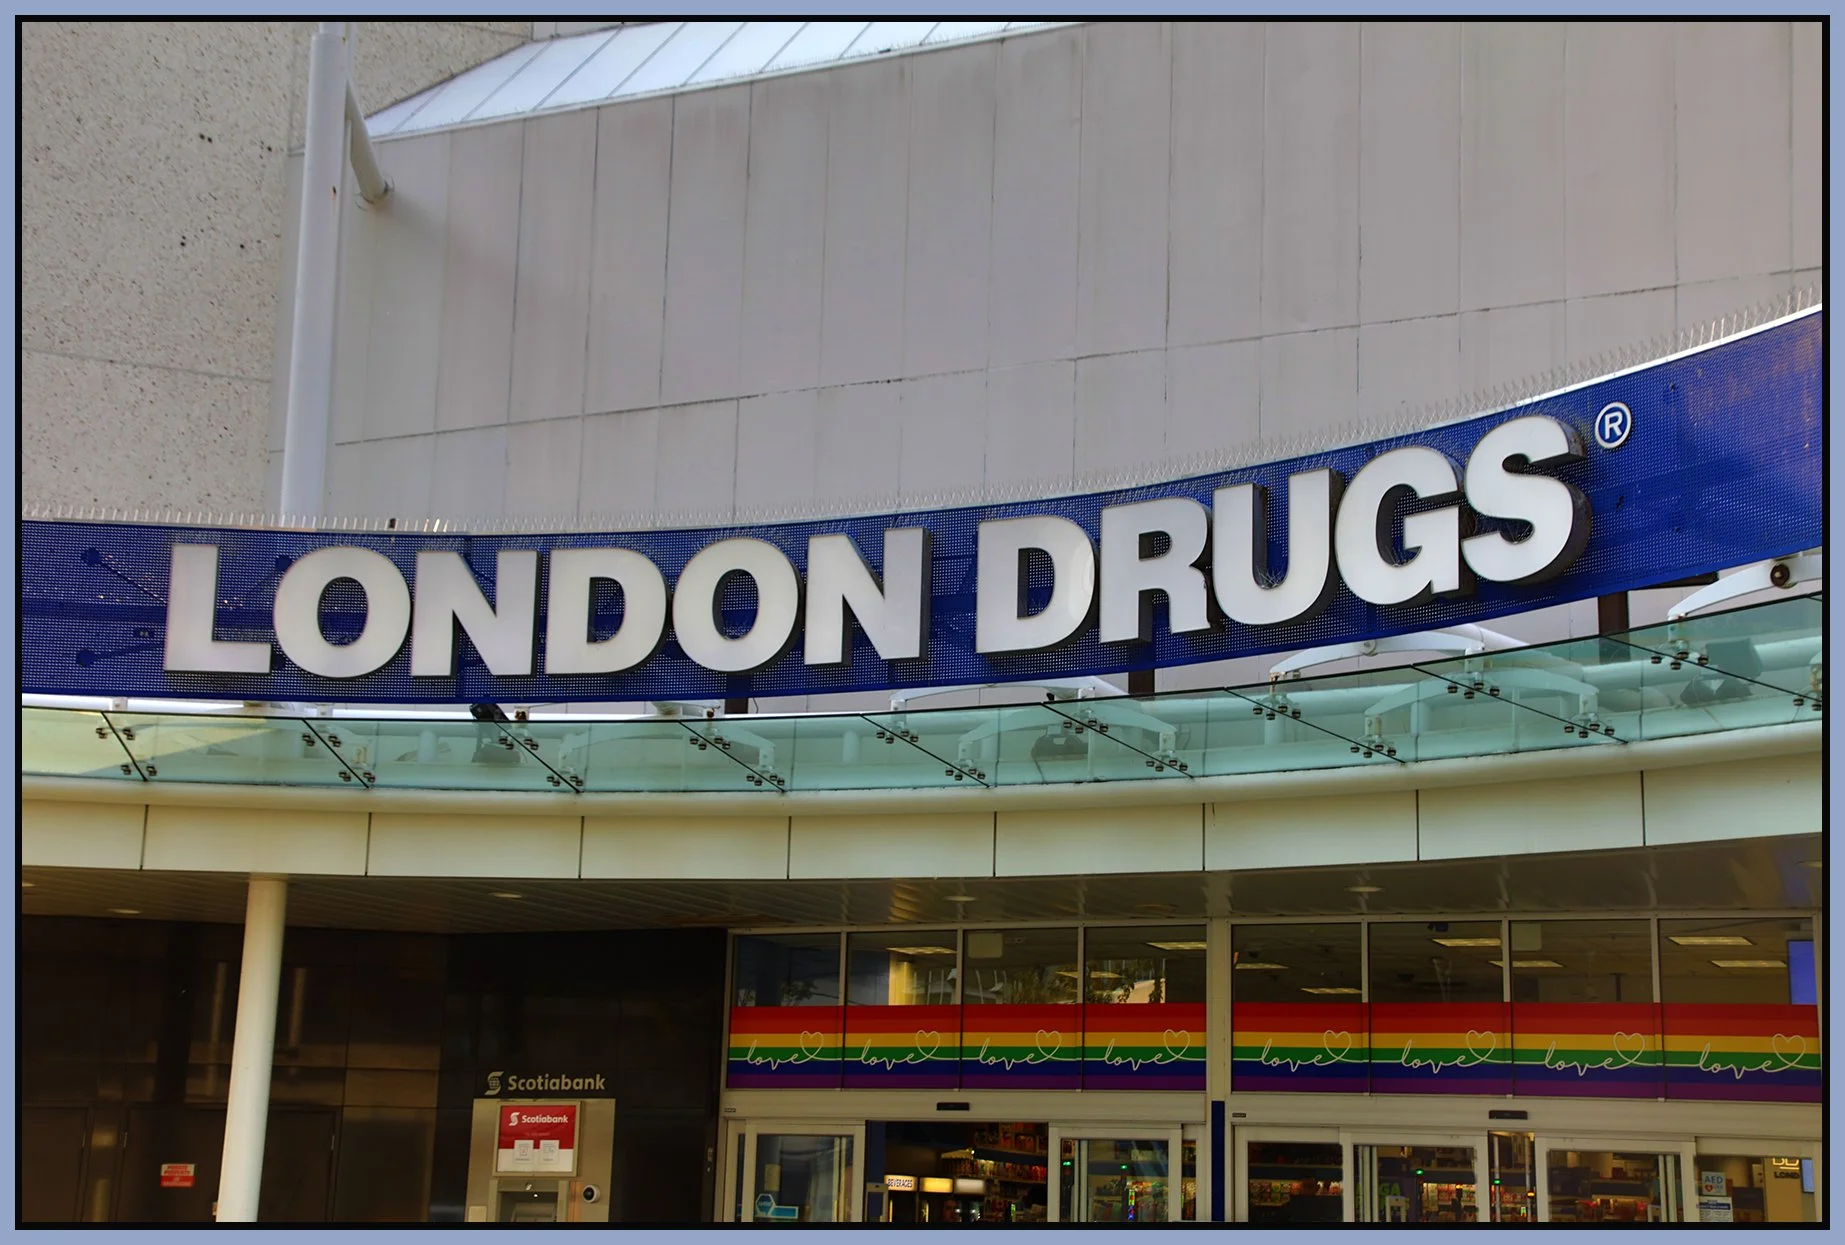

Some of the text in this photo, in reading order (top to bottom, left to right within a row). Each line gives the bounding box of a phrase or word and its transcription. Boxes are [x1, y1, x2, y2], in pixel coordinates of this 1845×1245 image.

[164, 526, 933, 680] LONDON
[976, 414, 1587, 654] DRUGS
[747, 1039, 800, 1070] love
[860, 1038, 916, 1070] love
[979, 1038, 1038, 1070] love
[1104, 1038, 1166, 1070] love
[1261, 1038, 1325, 1072] love
[1401, 1039, 1468, 1074] love
[1544, 1040, 1614, 1076] love
[1699, 1042, 1772, 1079] love
[507, 1073, 606, 1091] Scotiabank
[521, 1114, 569, 1124] Scotiabank
[887, 1178, 913, 1188] BEVERAGES
[1704, 1175, 1724, 1184] AED
